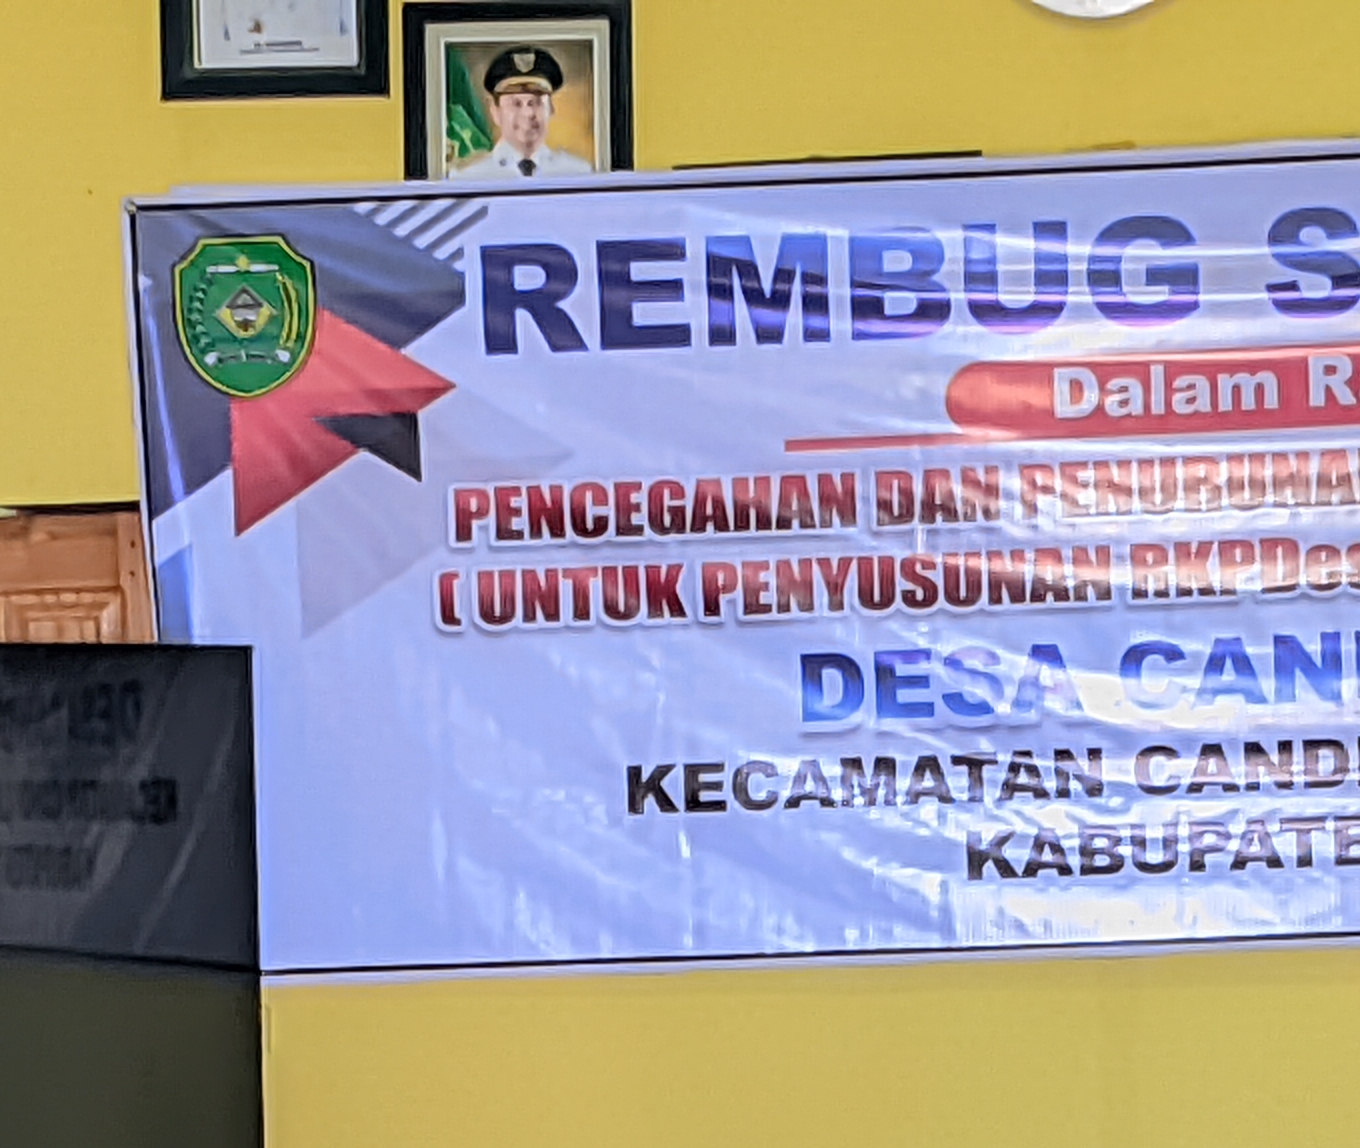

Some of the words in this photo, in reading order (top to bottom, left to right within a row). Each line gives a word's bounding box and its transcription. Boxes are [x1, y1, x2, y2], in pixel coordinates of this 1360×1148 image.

[481, 215, 1200, 354] REMBUG
[1054, 364, 1278, 420] Dalam
[454, 473, 857, 542] PENCEGAHAN
[876, 465, 1000, 526] DAN
[702, 545, 1112, 616] PENYUSUNAN
[800, 643, 1083, 723] DESA
[625, 746, 1104, 814] KECAMATAN
